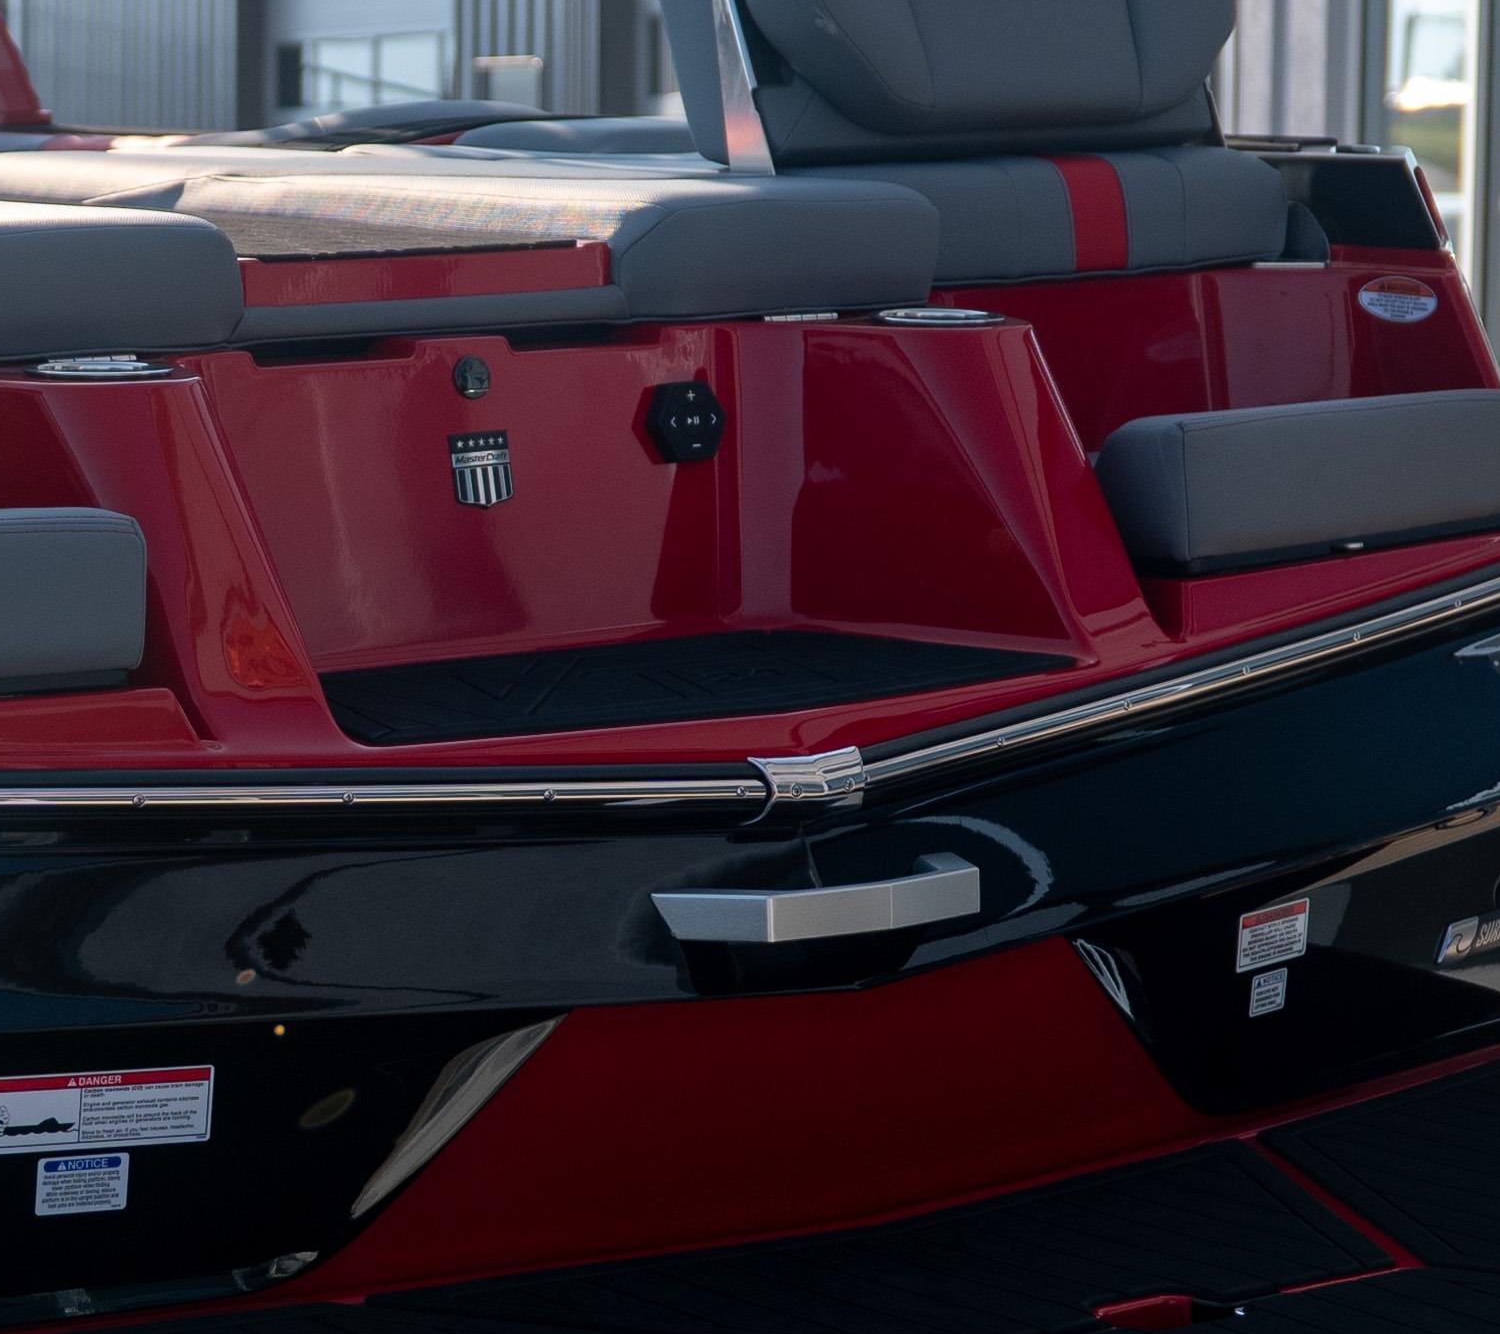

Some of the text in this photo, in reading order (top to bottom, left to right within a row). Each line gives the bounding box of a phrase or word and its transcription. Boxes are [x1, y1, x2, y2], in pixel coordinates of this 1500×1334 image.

[454, 451, 507, 465] MasterCraft
[78, 1075, 122, 1087] DANGER
[68, 1157, 109, 1170] NOTICE
